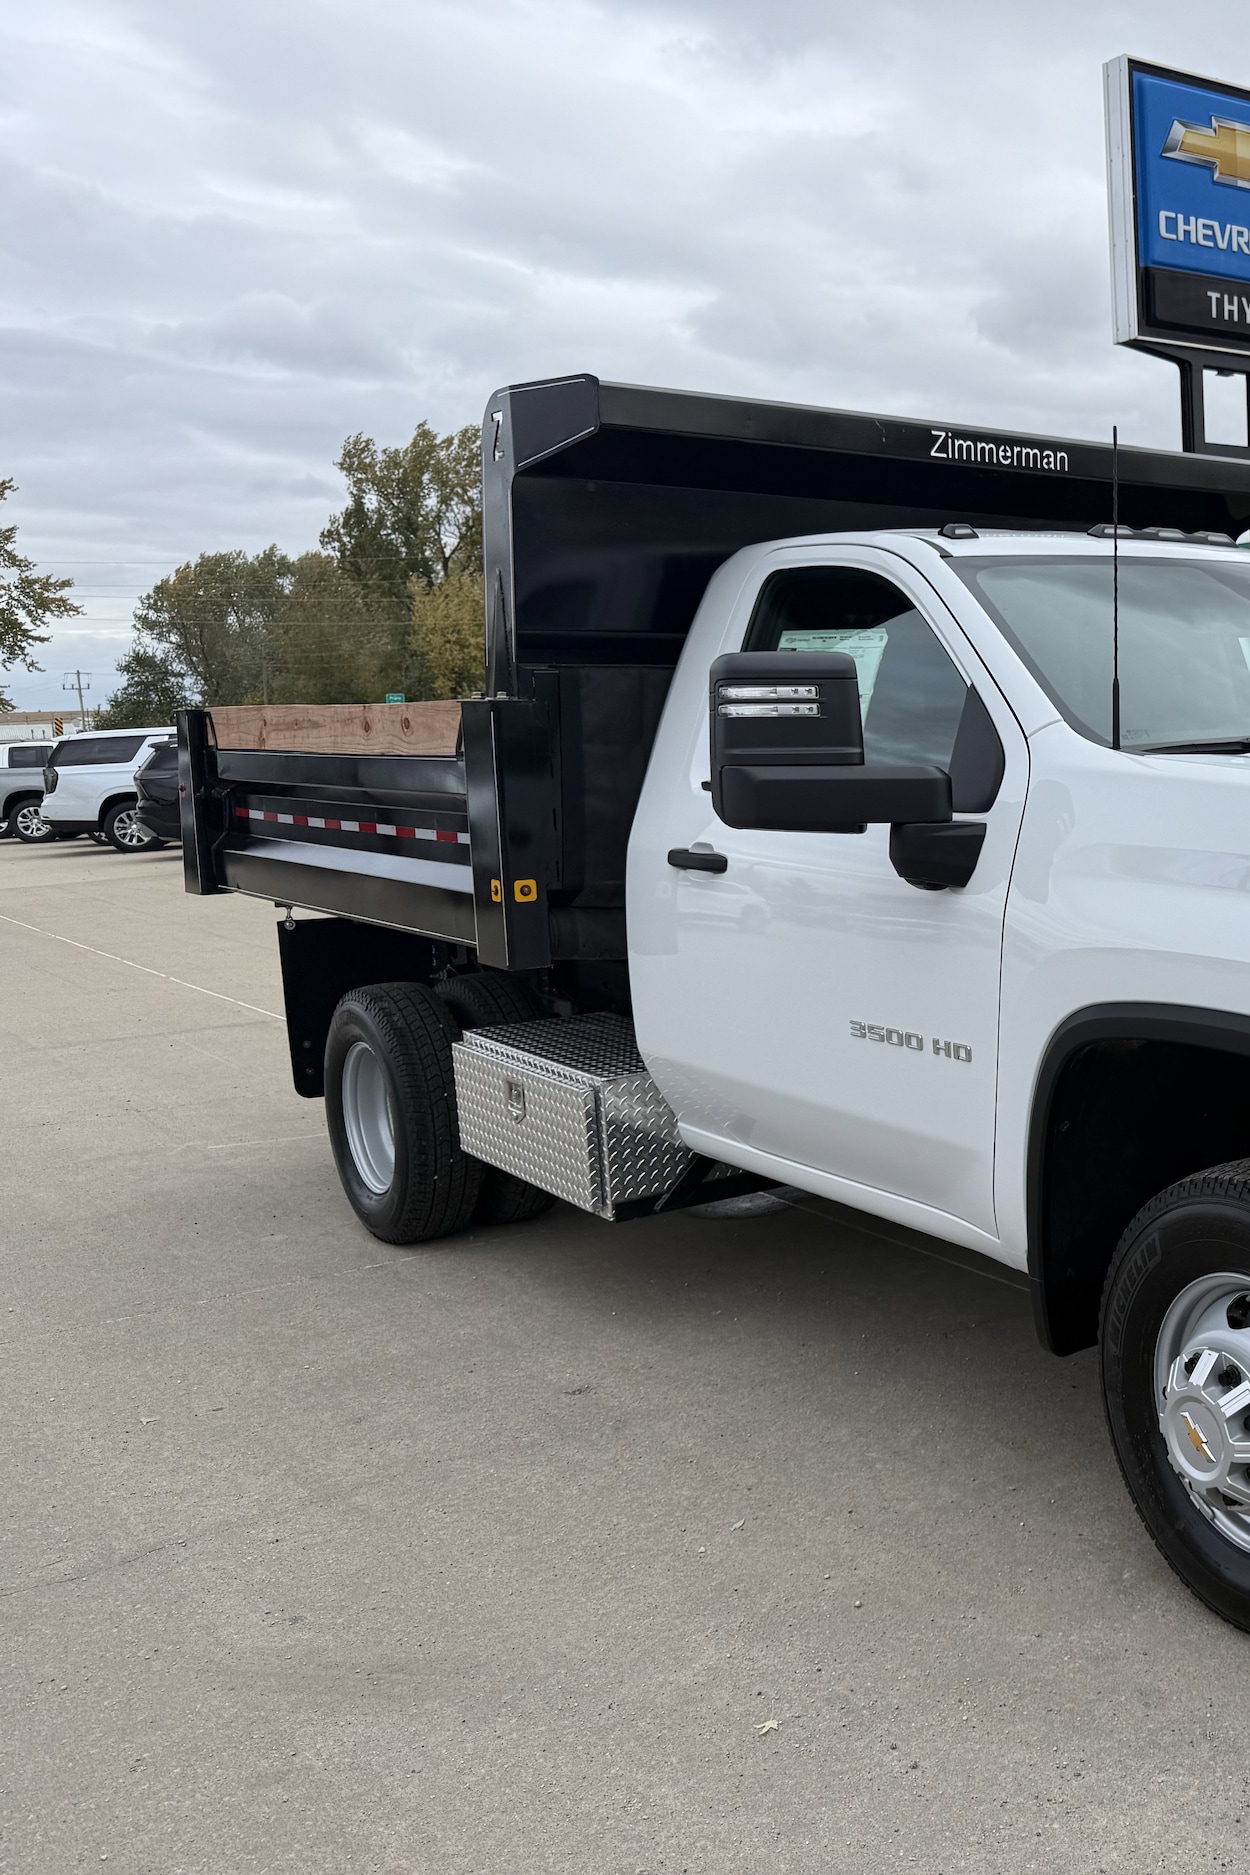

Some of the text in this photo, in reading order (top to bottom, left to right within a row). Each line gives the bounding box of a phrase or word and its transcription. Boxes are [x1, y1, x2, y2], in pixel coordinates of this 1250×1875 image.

[930, 430, 1069, 472] Zimmerman
[849, 1020, 973, 1063] 3500 HD
[1109, 1236, 1159, 1351] MICHELIN
